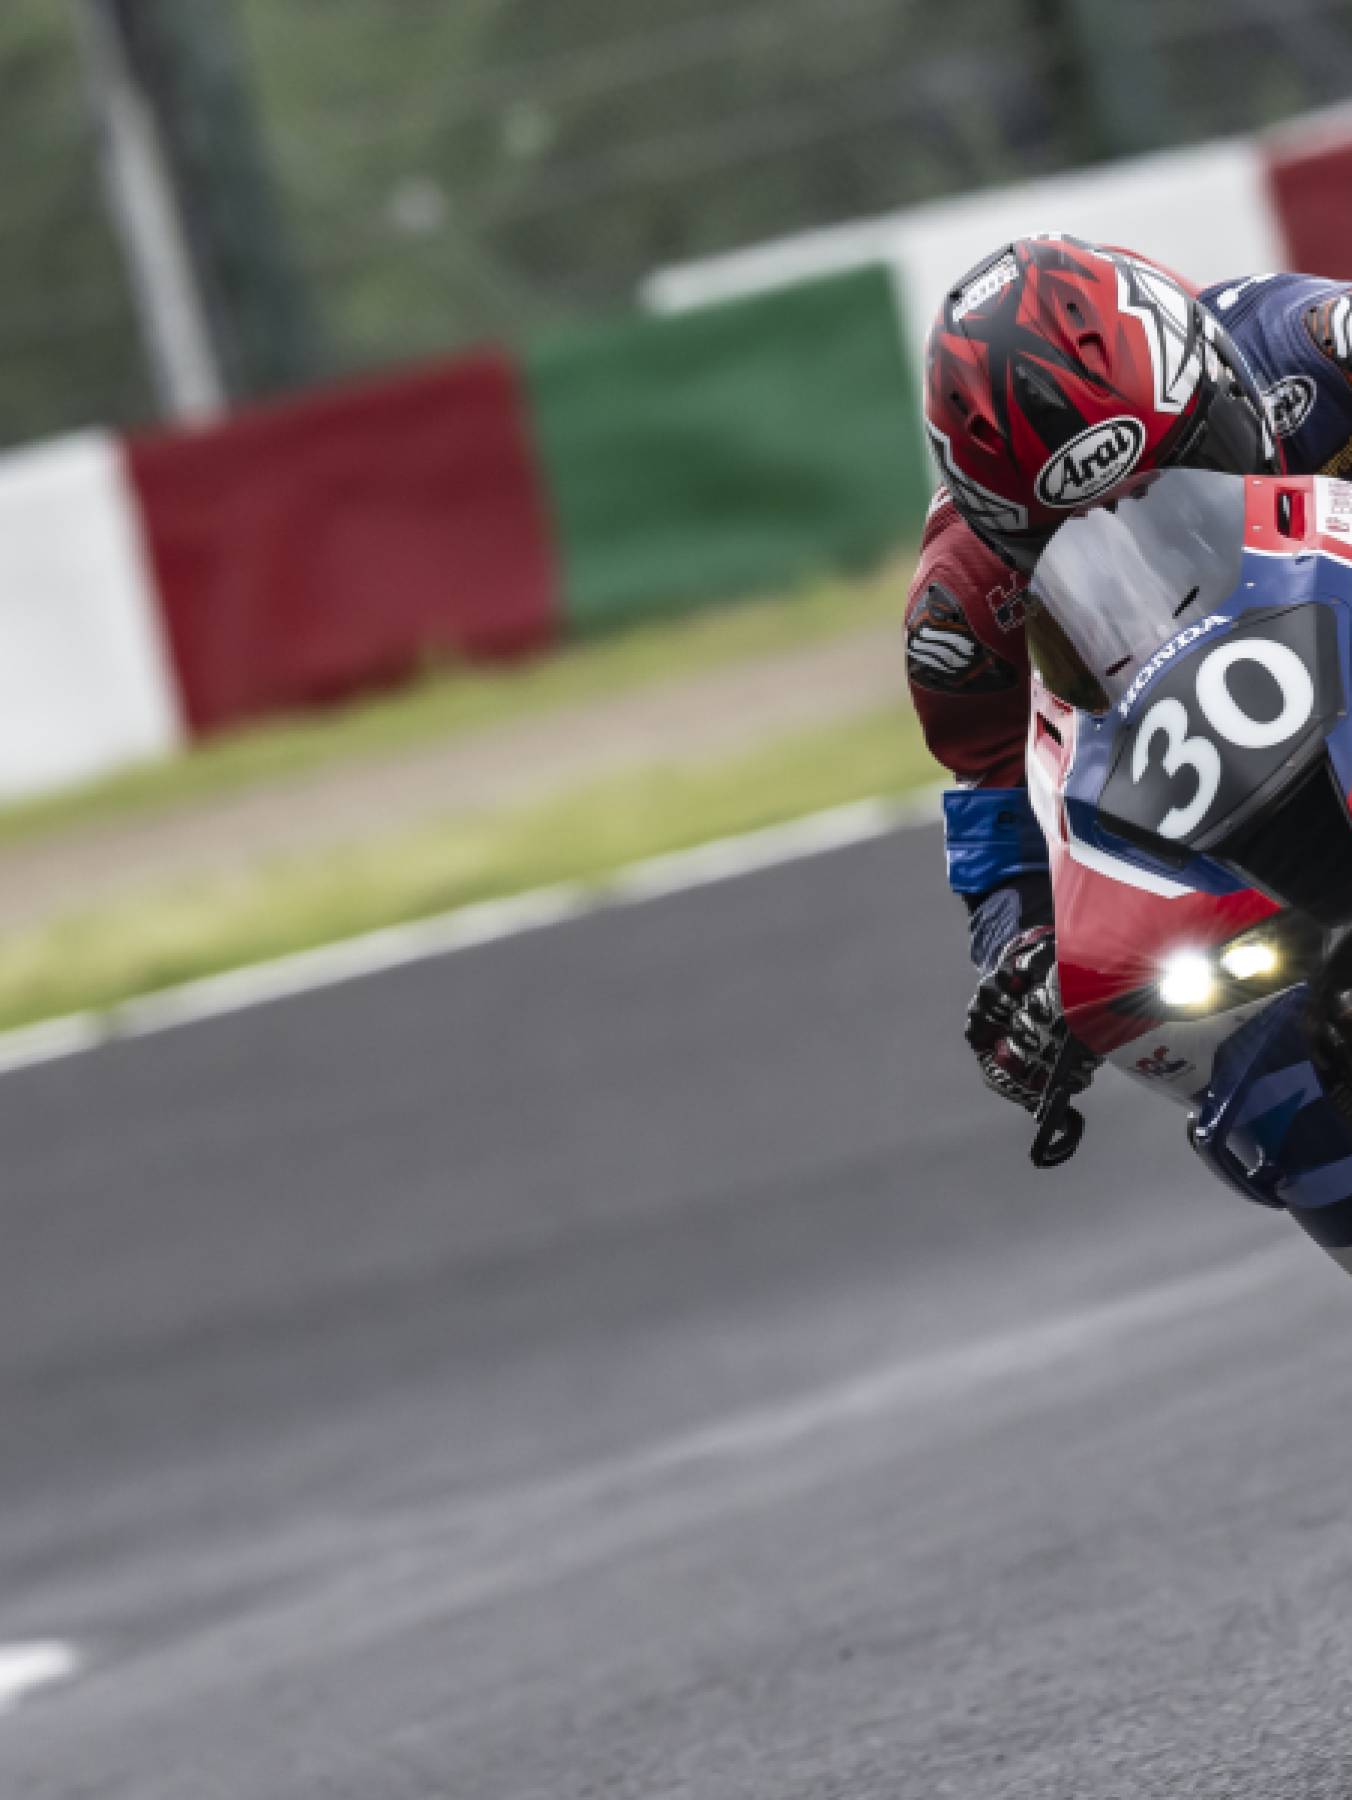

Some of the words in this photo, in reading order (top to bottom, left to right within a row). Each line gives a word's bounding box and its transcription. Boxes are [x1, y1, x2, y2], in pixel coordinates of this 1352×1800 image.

[1053, 425, 1132, 501] Arai
[1118, 615, 1233, 719] HONDA
[1131, 637, 1315, 841] 30
